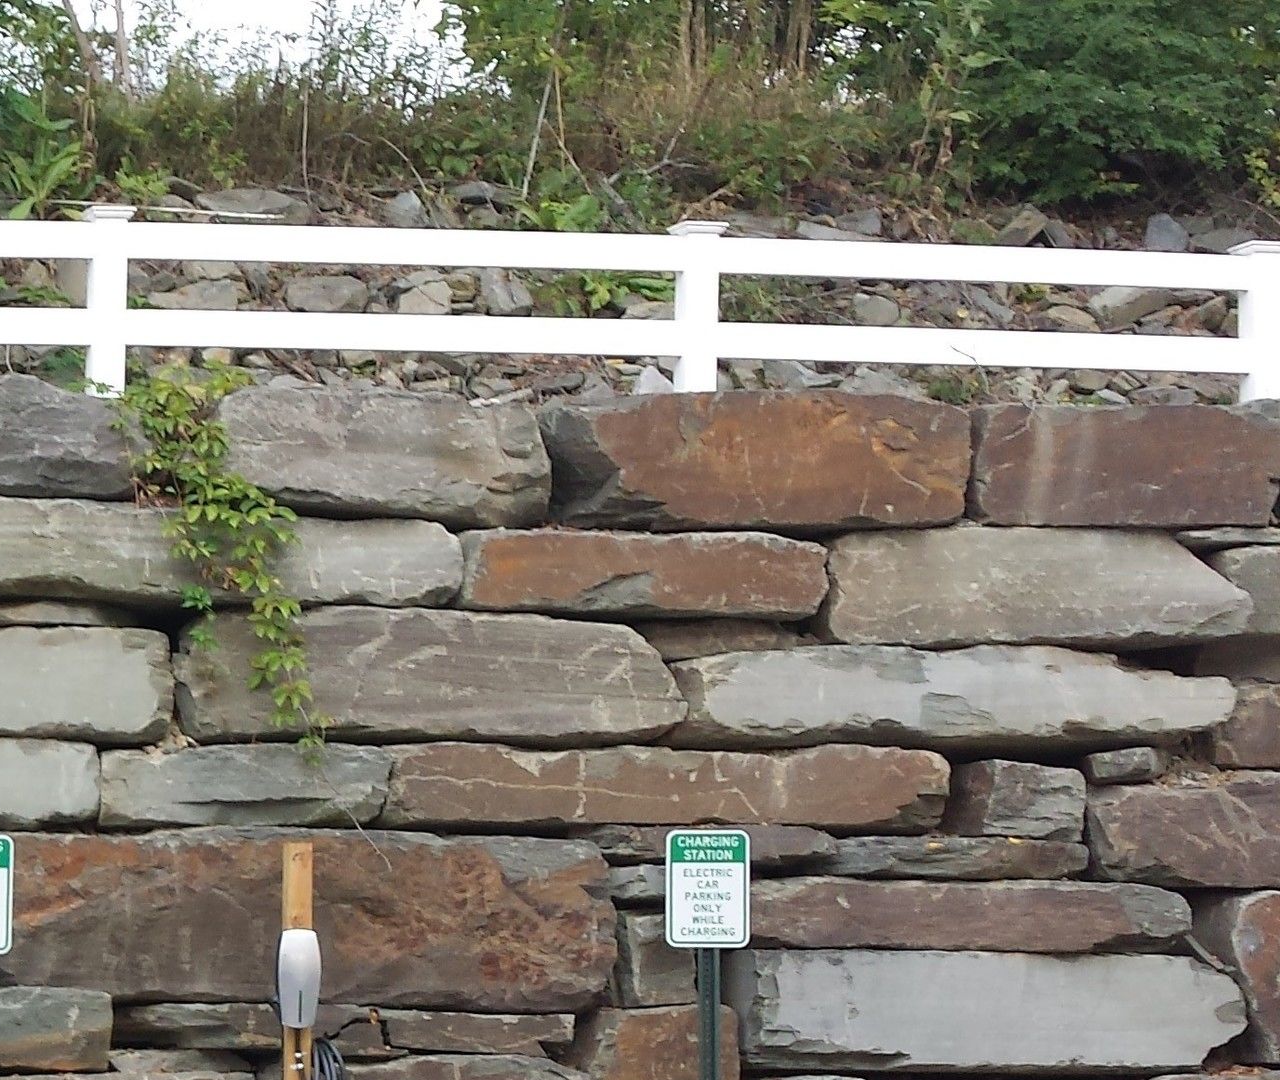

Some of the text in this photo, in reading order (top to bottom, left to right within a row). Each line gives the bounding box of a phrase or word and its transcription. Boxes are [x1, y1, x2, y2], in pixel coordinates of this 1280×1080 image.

[677, 836, 739, 847] CHARGING
[683, 849, 733, 860] STATION
[683, 868, 733, 878] ELECTRIC
[697, 880, 719, 889] CAR
[684, 892, 731, 901] PARKING
[693, 904, 721, 913] ONLY
[692, 915, 724, 924] WHILE
[680, 927, 736, 936] CHARGING
